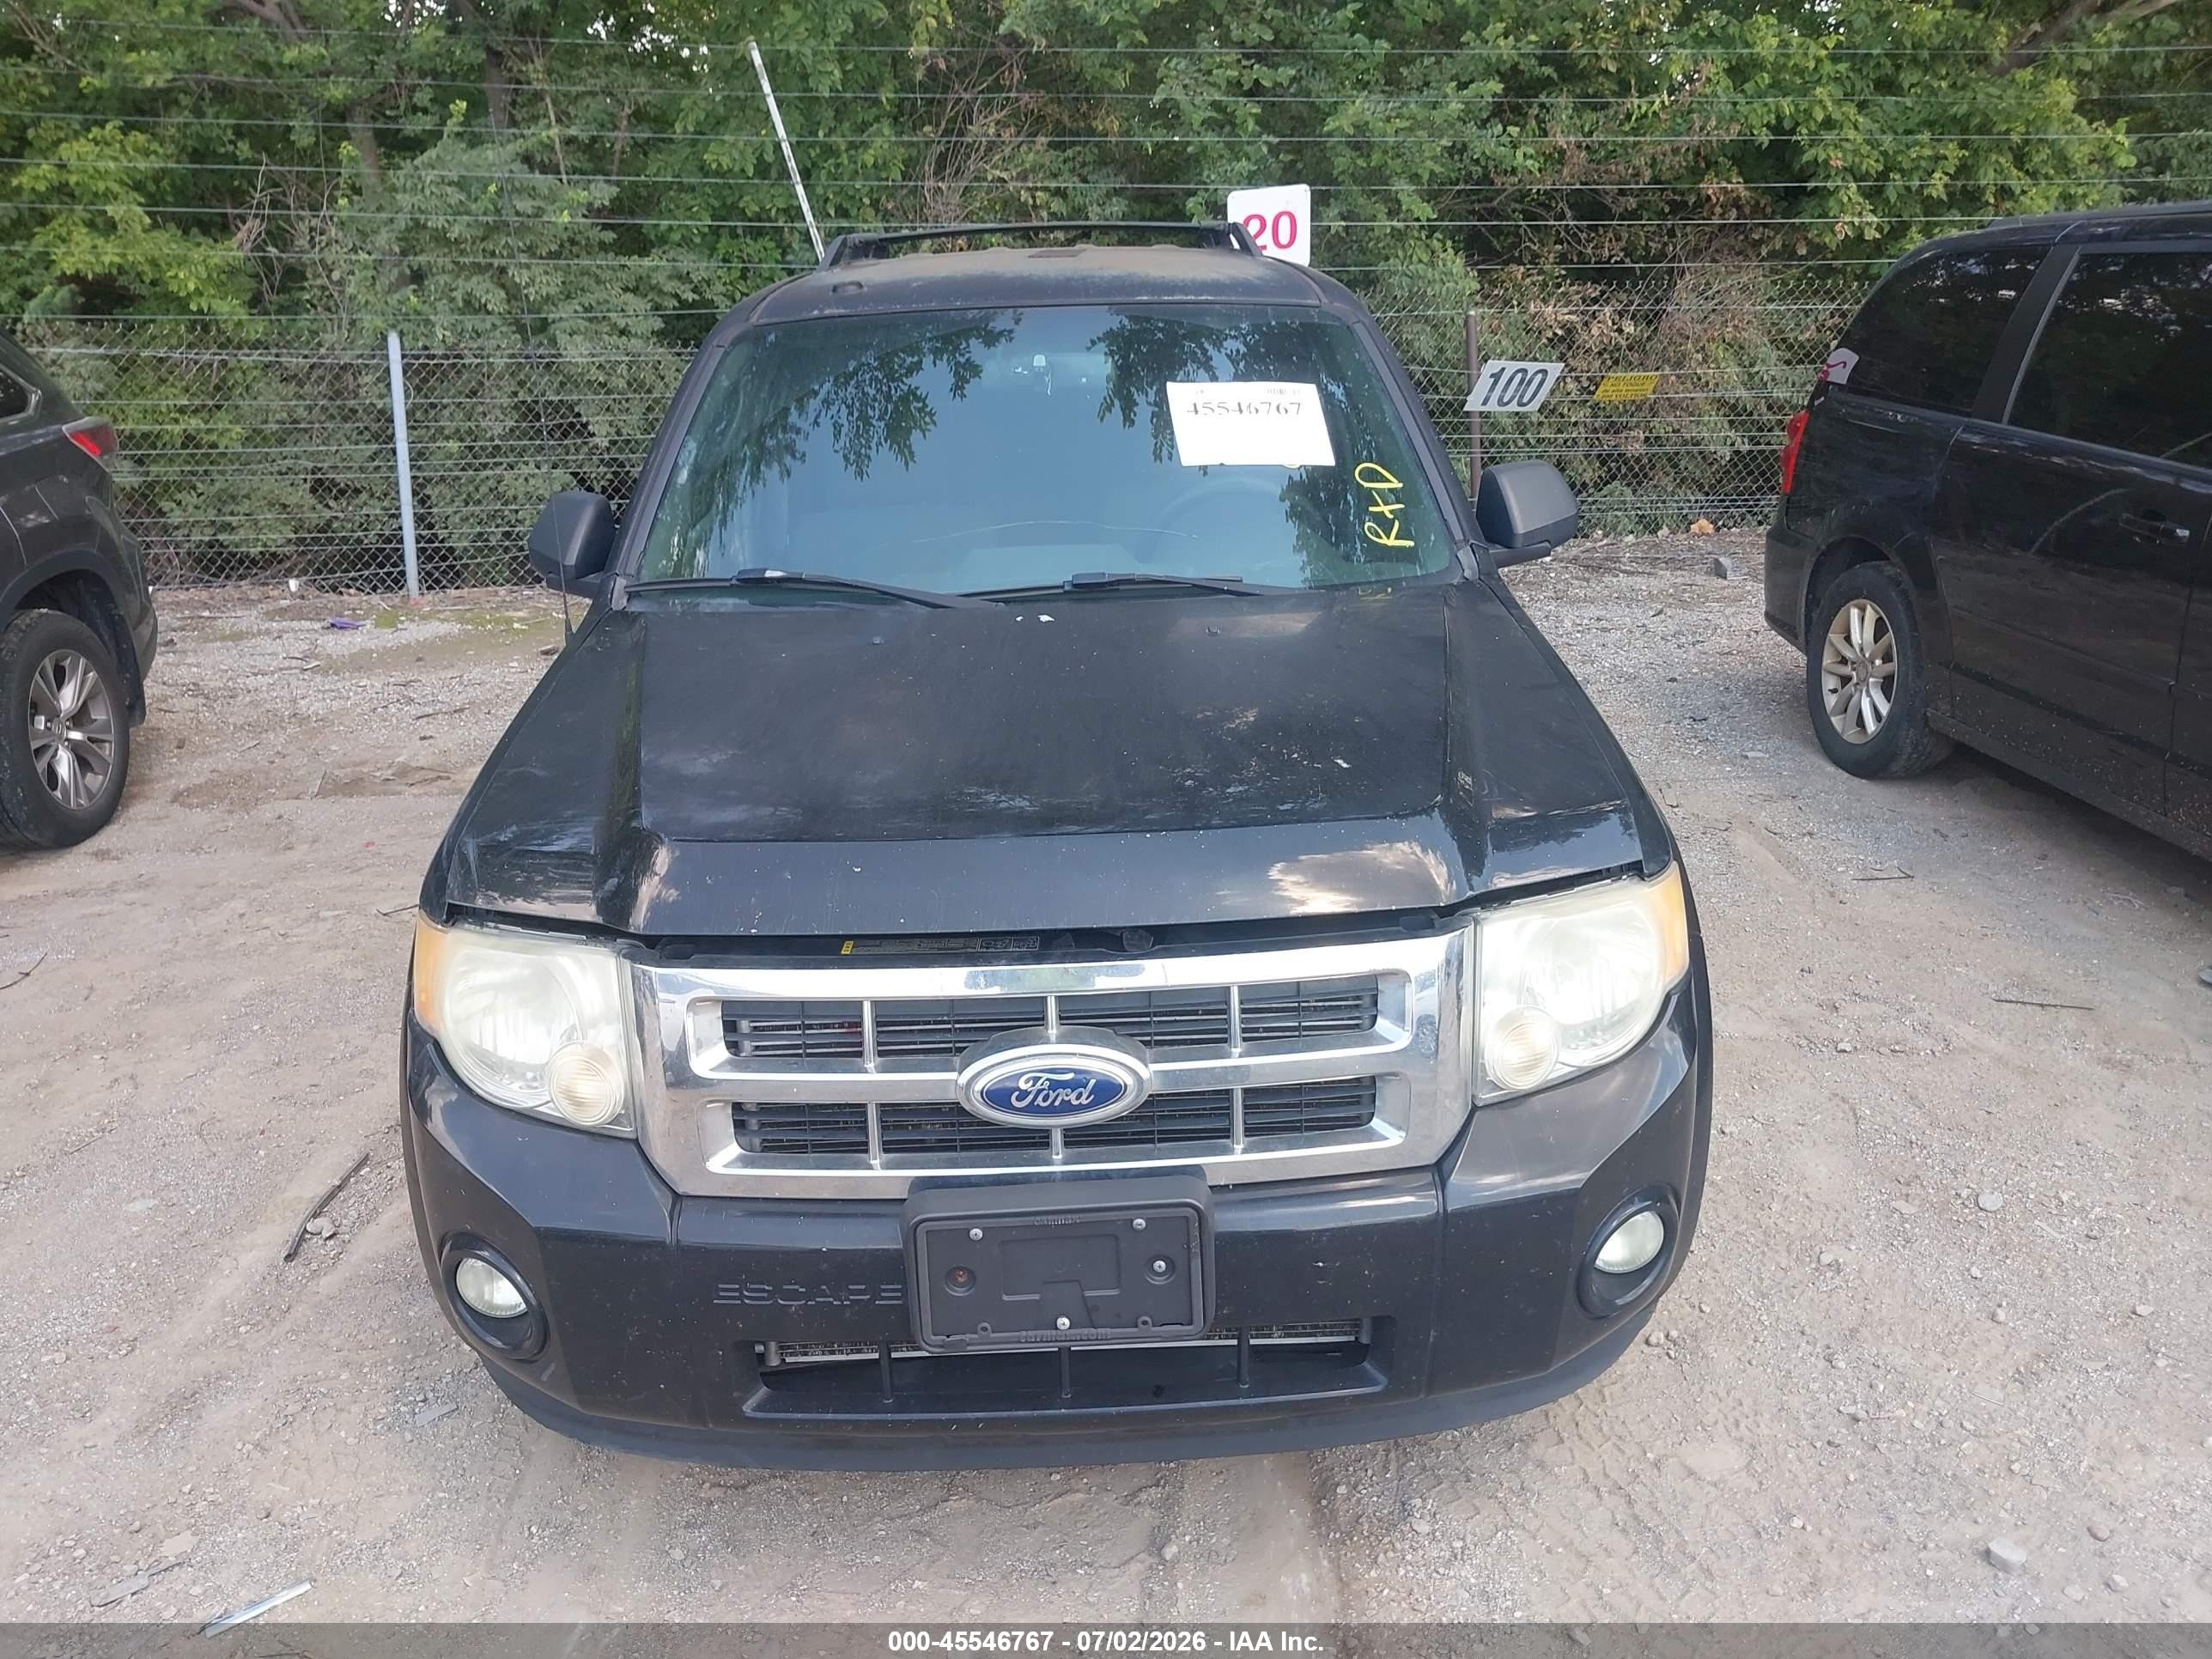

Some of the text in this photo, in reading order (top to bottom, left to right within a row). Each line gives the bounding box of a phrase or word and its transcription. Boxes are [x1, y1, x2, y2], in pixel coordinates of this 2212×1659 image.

[1243, 210, 1297, 251] 20
[1480, 367, 1548, 408] 100
[1187, 401, 1301, 416] 45546767
[1010, 1073, 1097, 1109] Ford
[713, 1284, 902, 1305] ESCAPE
